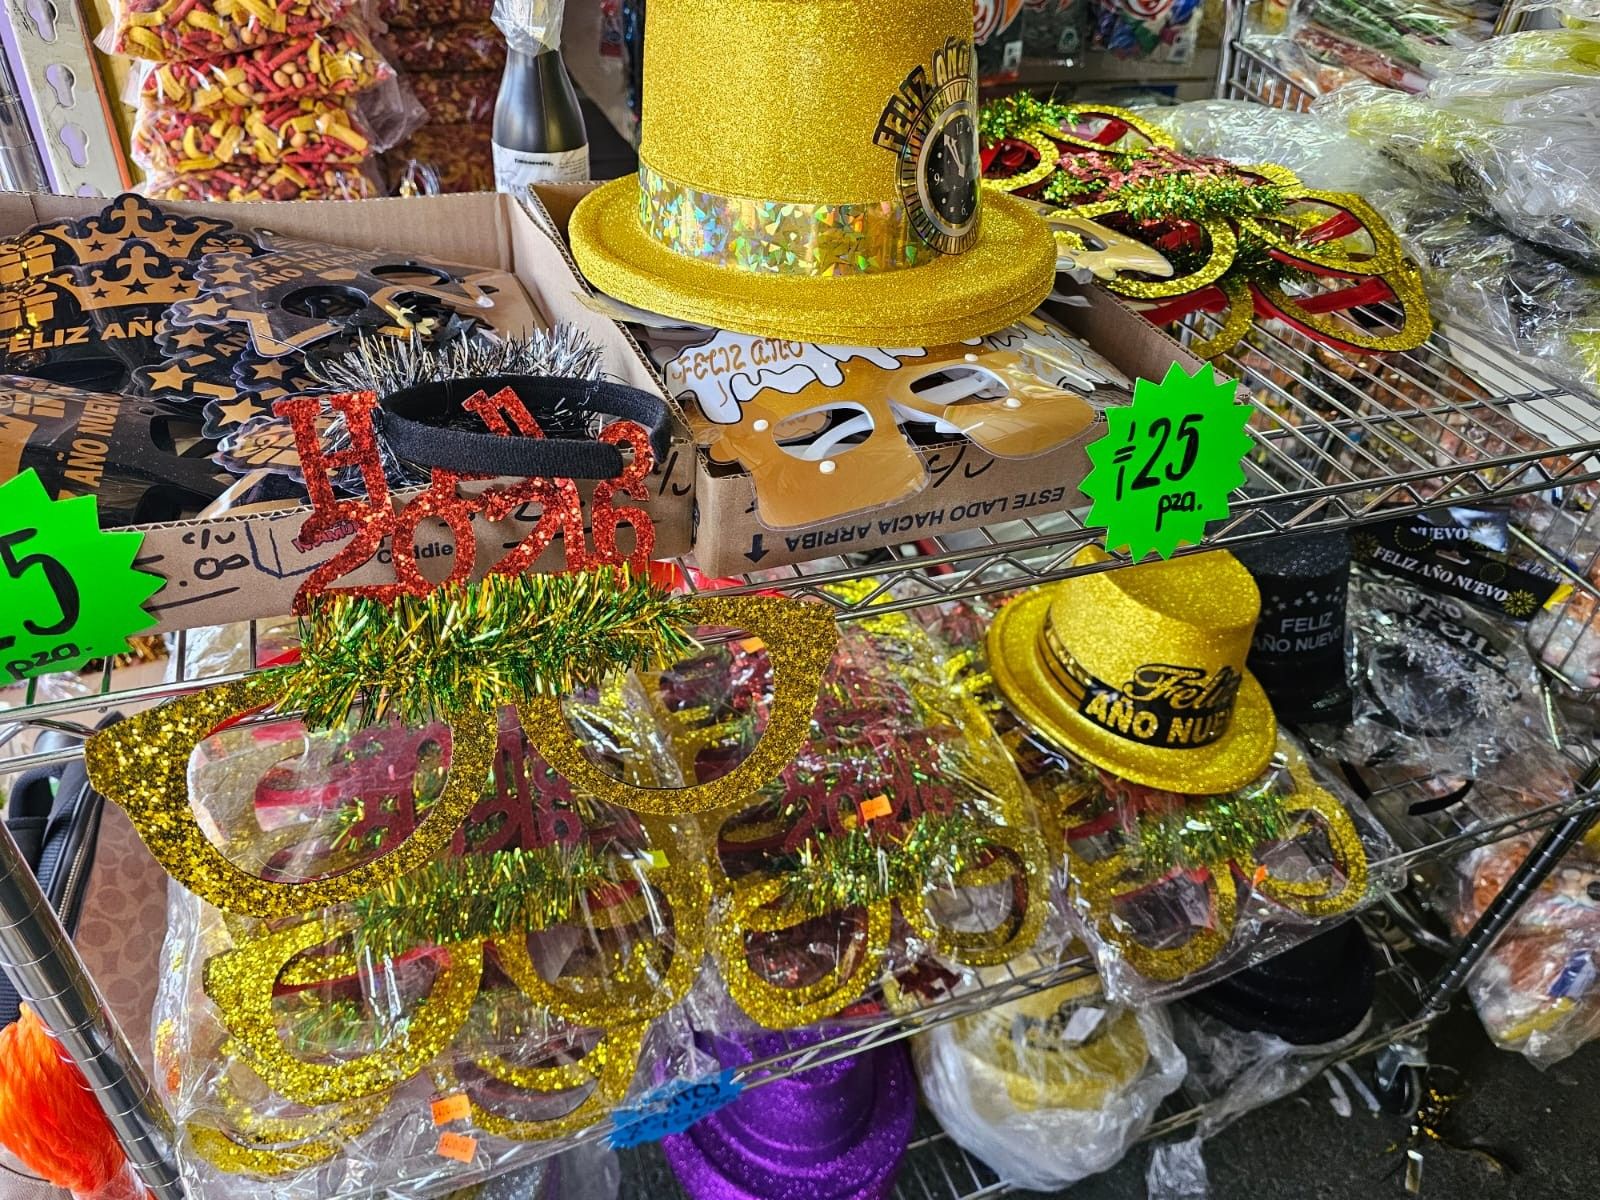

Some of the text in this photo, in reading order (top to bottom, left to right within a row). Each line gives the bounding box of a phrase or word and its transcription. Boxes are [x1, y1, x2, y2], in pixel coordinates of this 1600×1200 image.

[784, 486, 1066, 551] ESTE LADO HACIA ARRIBA
[1154, 490, 1203, 533] pza.
[1373, 546, 1421, 572] FELIZ
[1420, 561, 1454, 585] AÑO
[1451, 576, 1509, 603] NUEVO
[1280, 611, 1334, 634] FELIZ
[1085, 692, 1159, 739] AÑO
